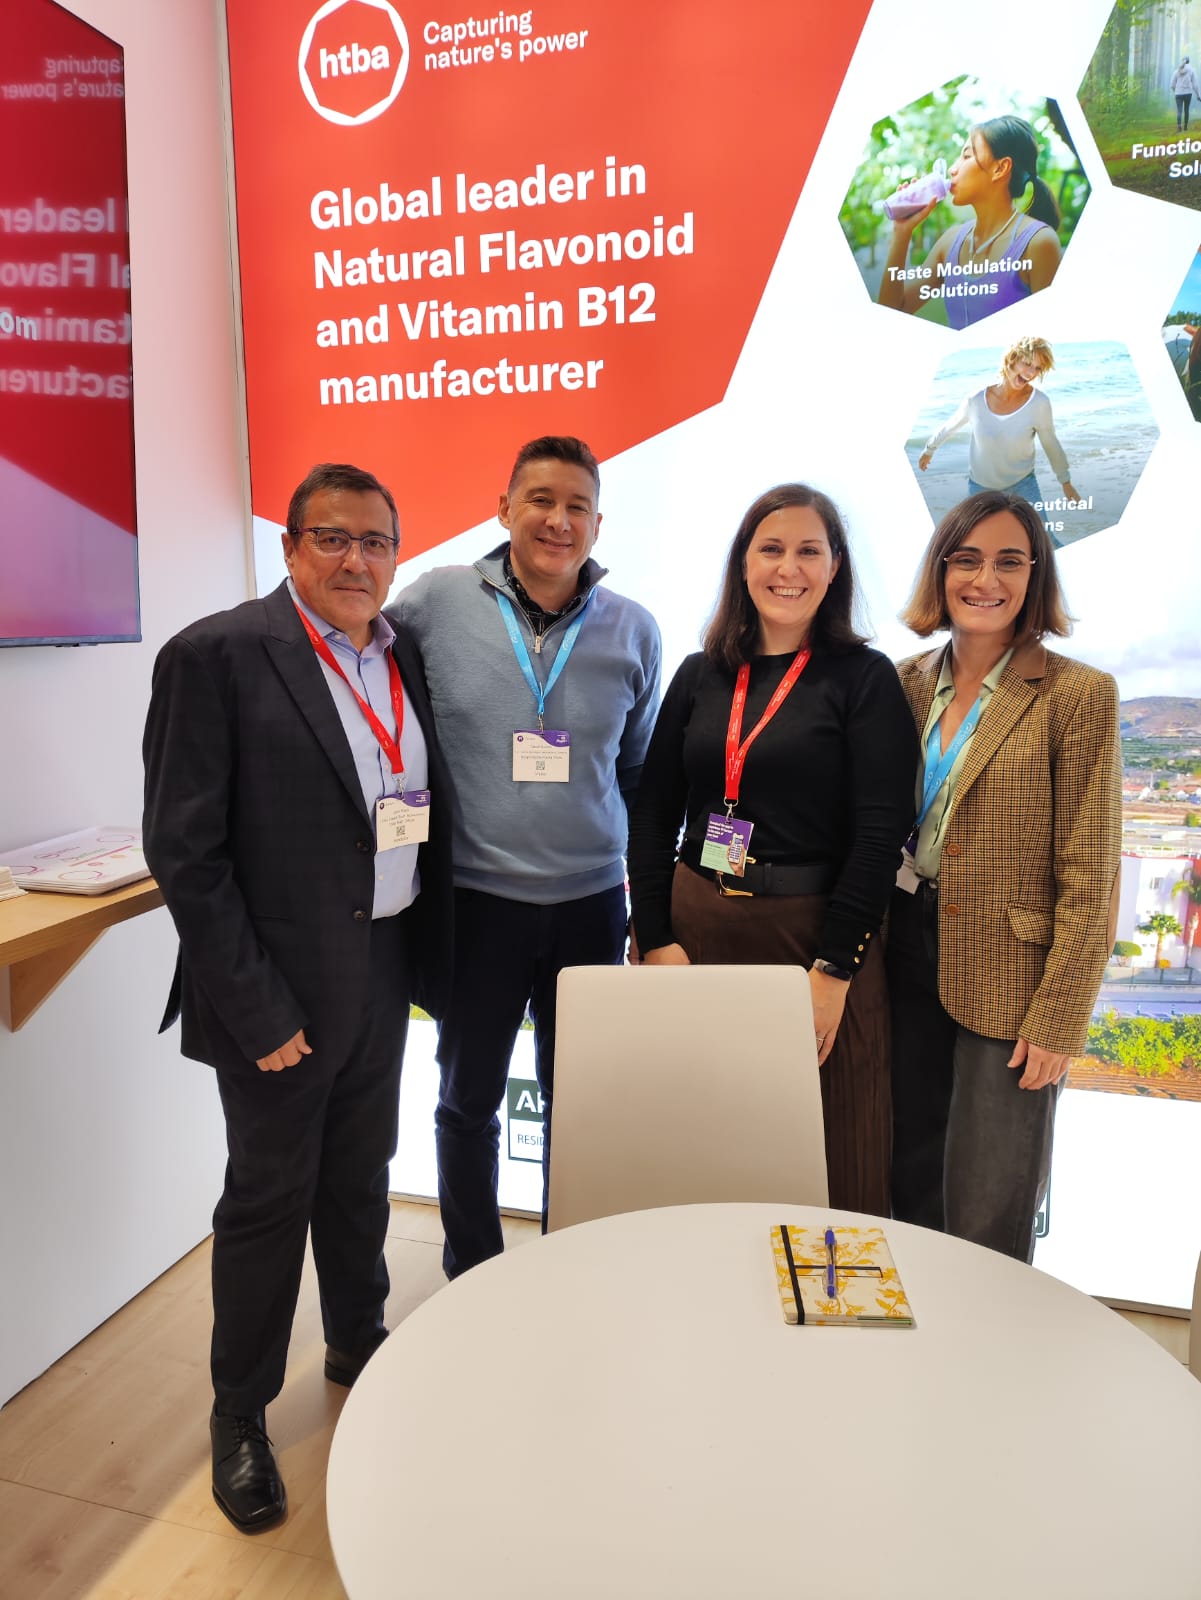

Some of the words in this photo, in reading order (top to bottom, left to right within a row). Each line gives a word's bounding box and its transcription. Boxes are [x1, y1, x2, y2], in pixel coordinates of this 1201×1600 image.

[423, 10, 533, 46] Capturing
[319, 43, 390, 79] htba
[424, 37, 513, 71] nature's
[519, 29, 589, 62] power
[1131, 137, 1201, 160] Functio
[310, 176, 442, 231] Global
[455, 163, 595, 215] leader
[605, 155, 647, 199] in
[313, 235, 466, 289] Natural
[479, 211, 694, 273] Flavonoid
[887, 266, 932, 282] Taste
[936, 257, 1034, 278] Modulation
[918, 281, 1000, 300] Solutions
[315, 303, 390, 348] and
[397, 291, 563, 341] Vitamin
[578, 283, 657, 327] B12
[318, 357, 605, 405] manufacturer
[1029, 495, 1093, 512] eutical
